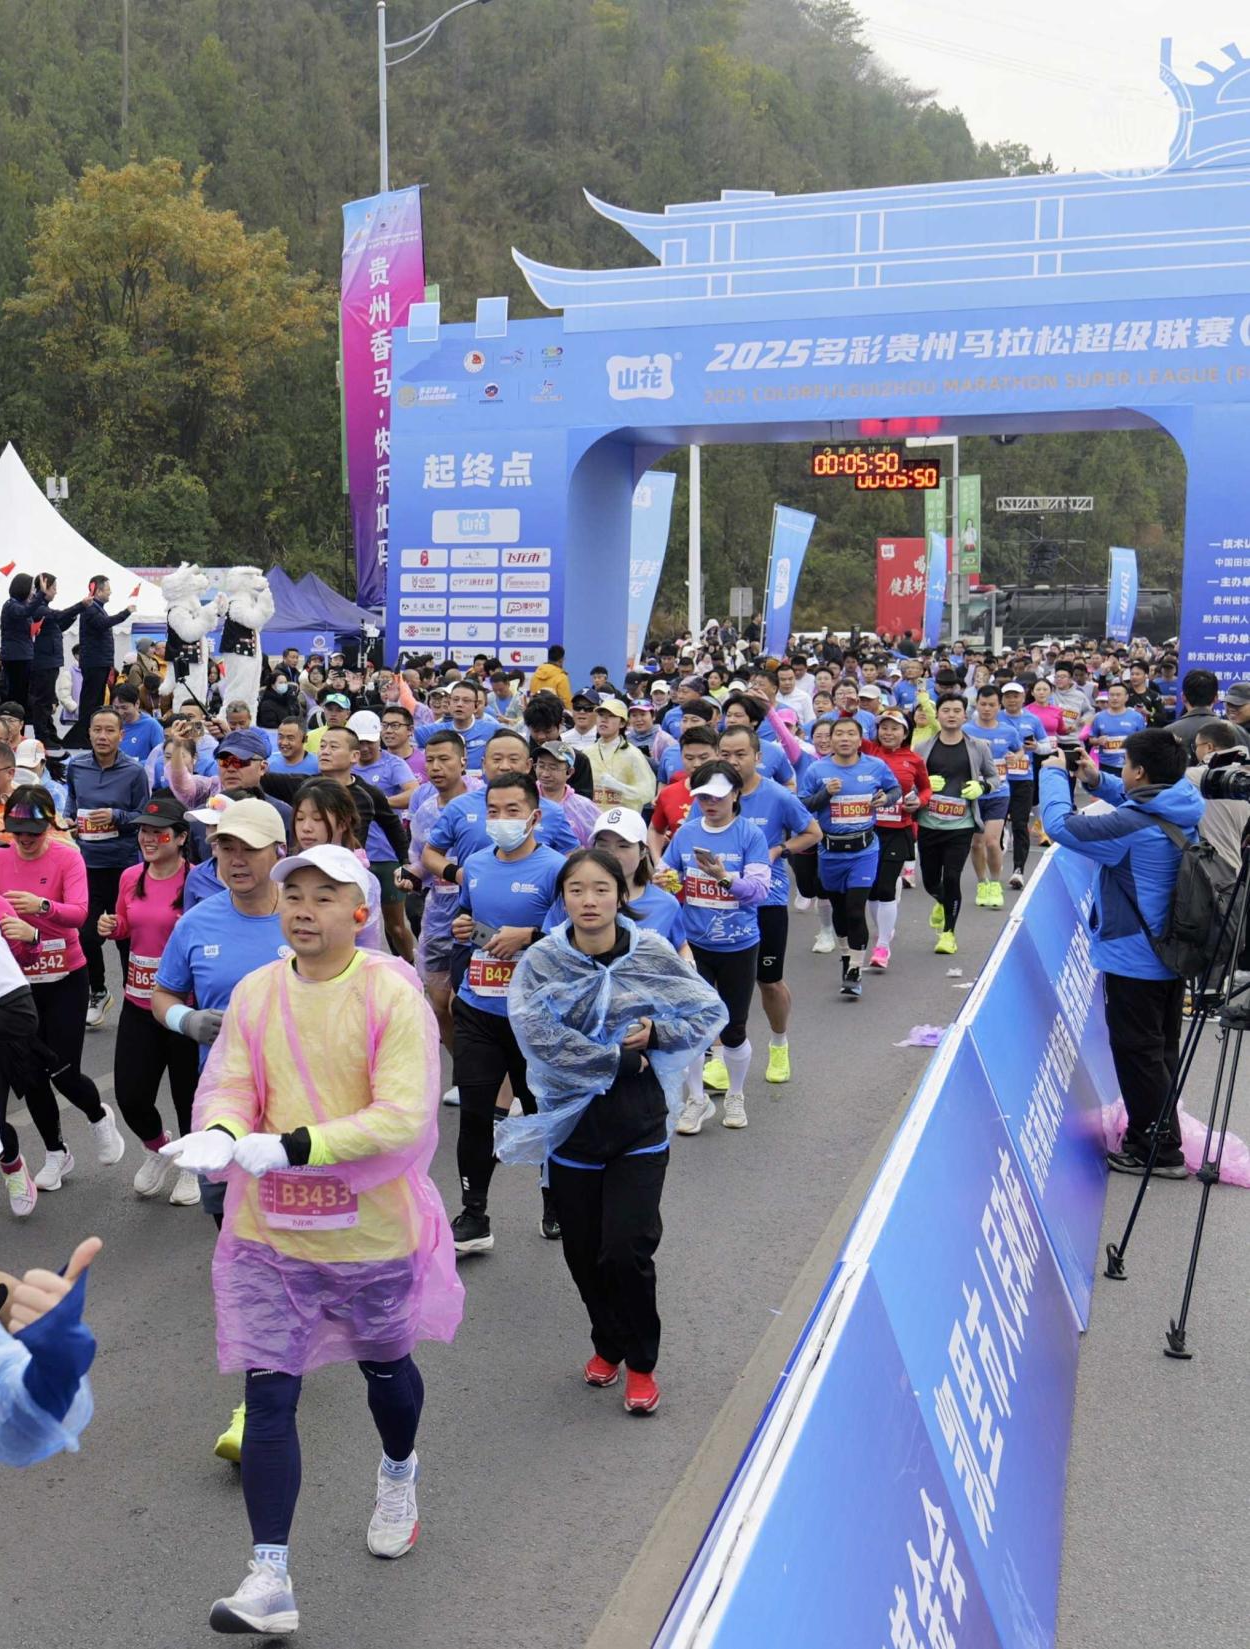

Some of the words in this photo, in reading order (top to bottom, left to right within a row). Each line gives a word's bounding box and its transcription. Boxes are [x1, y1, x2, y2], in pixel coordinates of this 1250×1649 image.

[616, 364, 664, 391] 山花
[944, 373, 1059, 395] MARATHON
[1064, 370, 1130, 389] SUPER
[1137, 367, 1219, 385] LEAGUE
[422, 451, 534, 490] 起终点
[814, 452, 899, 475] 00:05:50
[607, 809, 622, 824] C
[281, 1183, 352, 1208] B3433
[932, 1146, 1040, 1549] 凯里市人民政府
